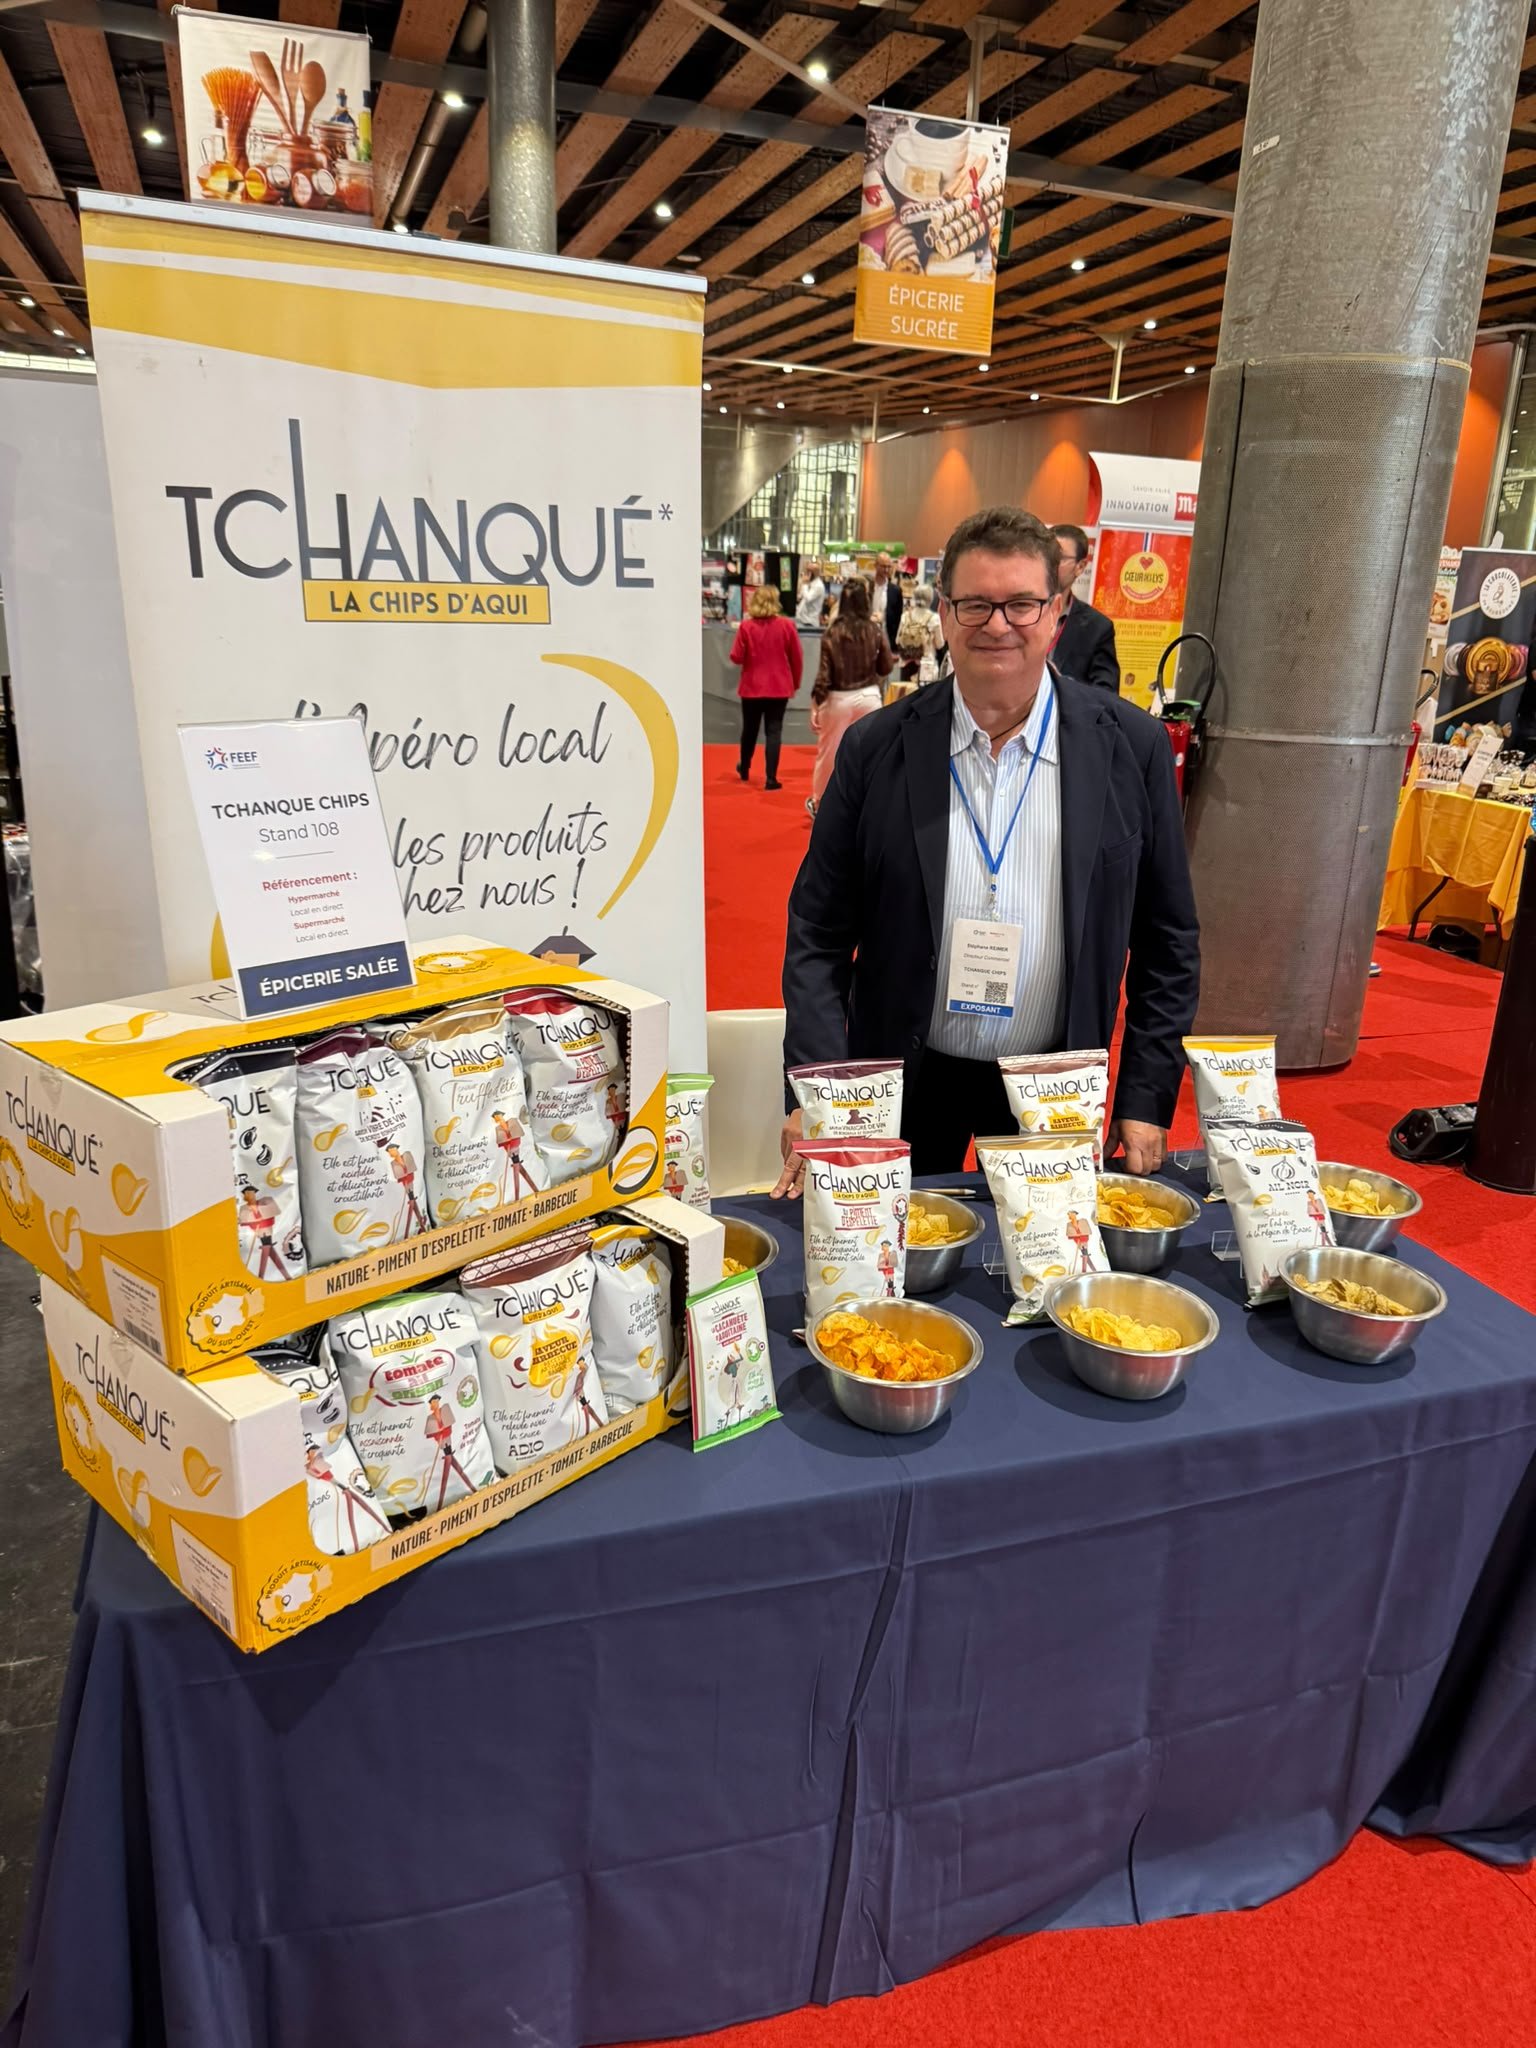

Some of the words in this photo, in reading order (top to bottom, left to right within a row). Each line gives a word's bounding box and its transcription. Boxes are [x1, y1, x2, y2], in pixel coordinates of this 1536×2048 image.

[888, 283, 965, 313] ÉPICERIE
[890, 315, 959, 341] SUCRÉE
[1105, 499, 1169, 513] INNOVATION
[329, 590, 362, 613] LA
[369, 591, 440, 614] CHIPS
[448, 592, 528, 616] D'AQUI
[499, 701, 613, 768] local
[230, 751, 257, 763] FEEF
[212, 797, 316, 819] TCHANQUE
[318, 793, 370, 811] CHIPS
[258, 824, 309, 843] Stand
[311, 821, 340, 838] 108
[392, 817, 446, 868] les
[458, 801, 608, 884] produits
[262, 872, 352, 891] Référencement
[479, 873, 557, 909] nous
[287, 890, 340, 904] Hypermarché
[290, 908, 310, 917] Local
[322, 903, 344, 912] direct
[293, 916, 345, 930] Supermarché
[295, 933, 315, 943] Local
[328, 929, 349, 938] direct
[259, 965, 343, 997] ÉPICERIE
[345, 956, 400, 983] SALÉE
[960, 1002, 1001, 1014] EXPOSANT
[1202, 1049, 1273, 1071] TCHANQUÉ
[813, 1078, 895, 1102] TCHANQUÉ
[1017, 1074, 1100, 1100] TCHANQUÉ
[1050, 1120, 1086, 1130] BARBECUE
[1052, 1116, 1079, 1124] SAVEUR
[811, 1162, 902, 1193] TCHANQUÉ
[1268, 1182, 1285, 1192] AIL
[1286, 1180, 1311, 1190] NOIR
[326, 1267, 370, 1295] NATURE
[378, 1246, 418, 1276] PIMENT
[421, 1225, 486, 1260] D'ESPELETTE
[492, 1210, 528, 1234] TOMATE
[533, 1188, 578, 1218] BARBECUE
[195, 1286, 219, 1318] PRODUIT
[206, 1337, 217, 1346] DU
[217, 1319, 255, 1347] SUD-OUEST
[336, 1308, 461, 1354] TCHANQUÉ
[384, 1356, 445, 1383] tomate
[492, 1409, 509, 1422] Elle
[509, 1408, 523, 1420] est
[522, 1401, 556, 1420] finement
[378, 1416, 415, 1435] finement
[508, 1440, 545, 1457] ADIO
[391, 1527, 432, 1561] NATURE
[439, 1502, 479, 1536] PIMENT
[482, 1468, 545, 1514] D'ESPELETTE
[550, 1448, 586, 1477] TOMATE
[588, 1420, 635, 1456] BARBECUE
[265, 1567, 289, 1600] PRODUIT
[276, 1616, 286, 1624] DU
[287, 1594, 323, 1624] SUD-OUEST
